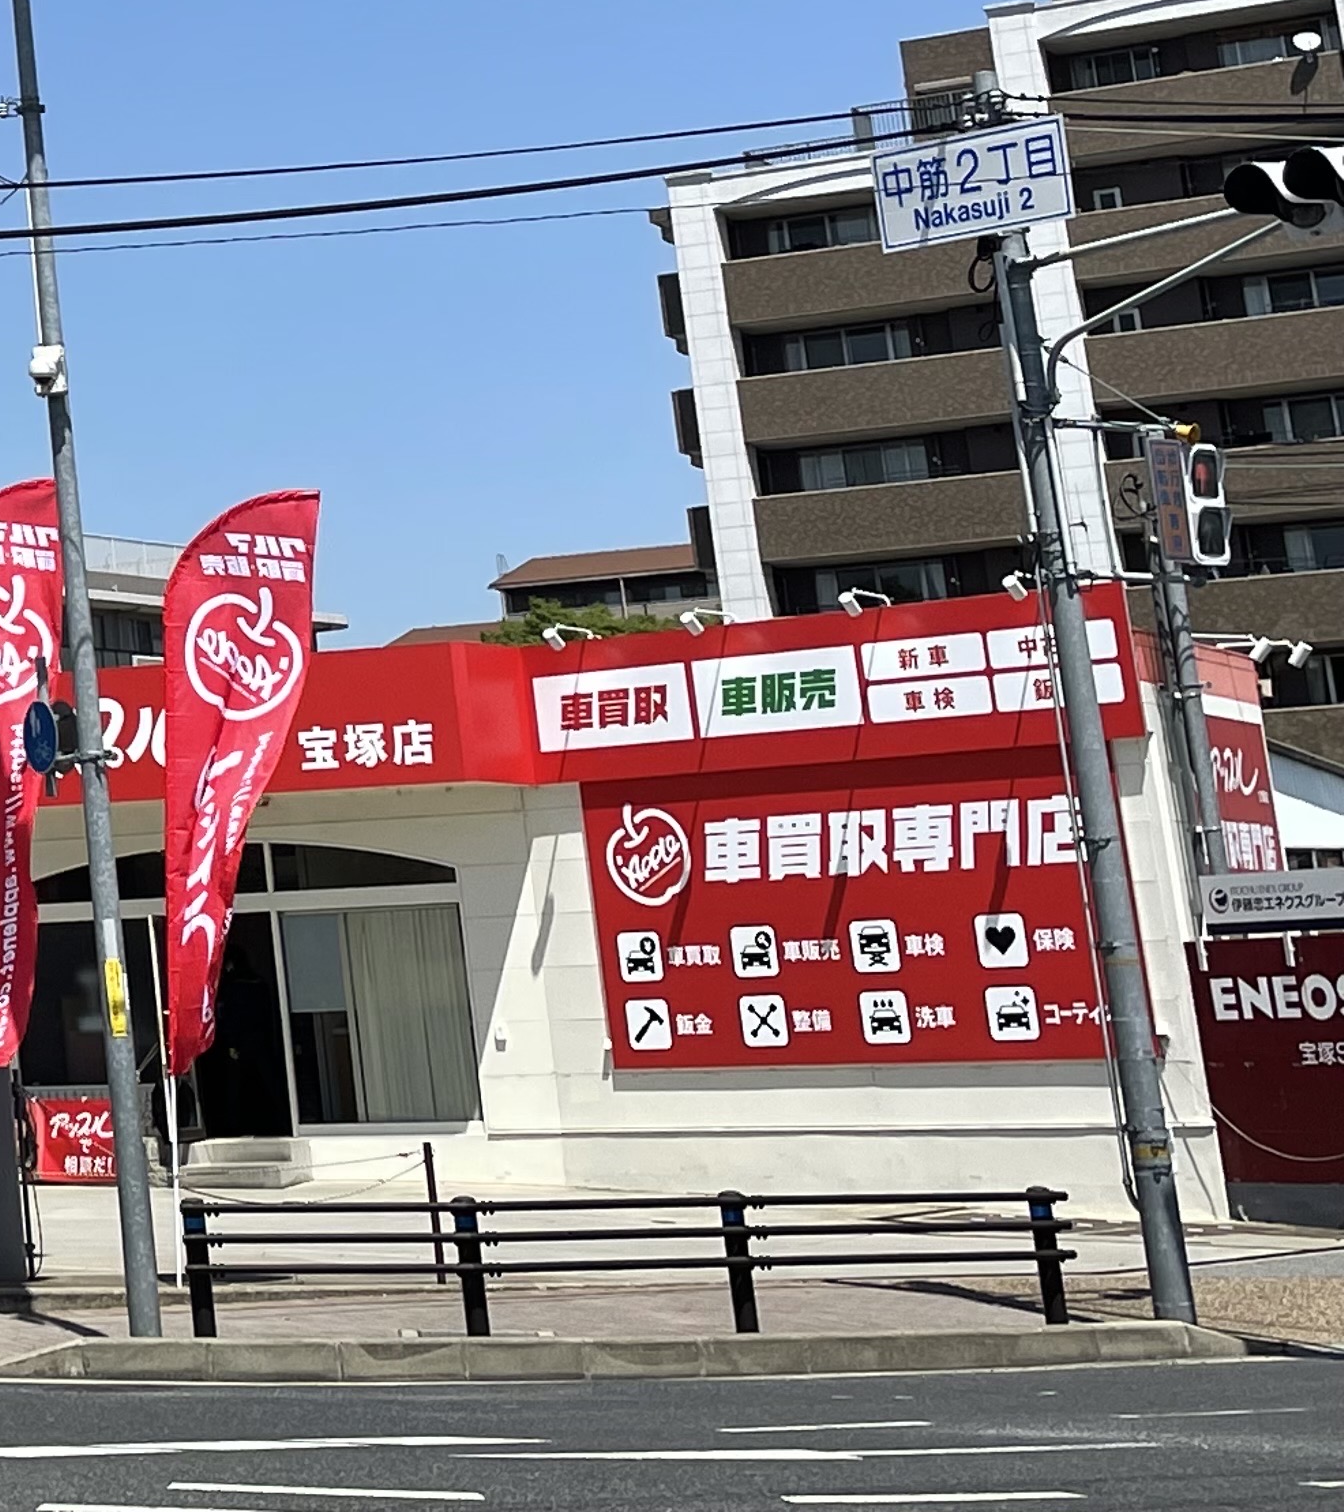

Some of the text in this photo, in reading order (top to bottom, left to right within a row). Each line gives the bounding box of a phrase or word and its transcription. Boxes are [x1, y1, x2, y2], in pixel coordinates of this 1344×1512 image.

[882, 134, 1057, 208] 中筋2丁目
[914, 187, 1034, 232] Nakasuji 2
[897, 643, 950, 671] 新車
[560, 683, 669, 732] 車買取
[721, 668, 837, 717] 車販売
[903, 686, 956, 713] 車検
[297, 719, 434, 771] 宝塚店
[703, 794, 1088, 884] 車買取専門店
[1221, 819, 1277, 872] 取専門店
[667, 944, 722, 968] 車買取
[782, 938, 841, 963] 車販売
[904, 932, 946, 958] 車検
[1032, 926, 1076, 953] 保険
[914, 1005, 957, 1029] 洗車
